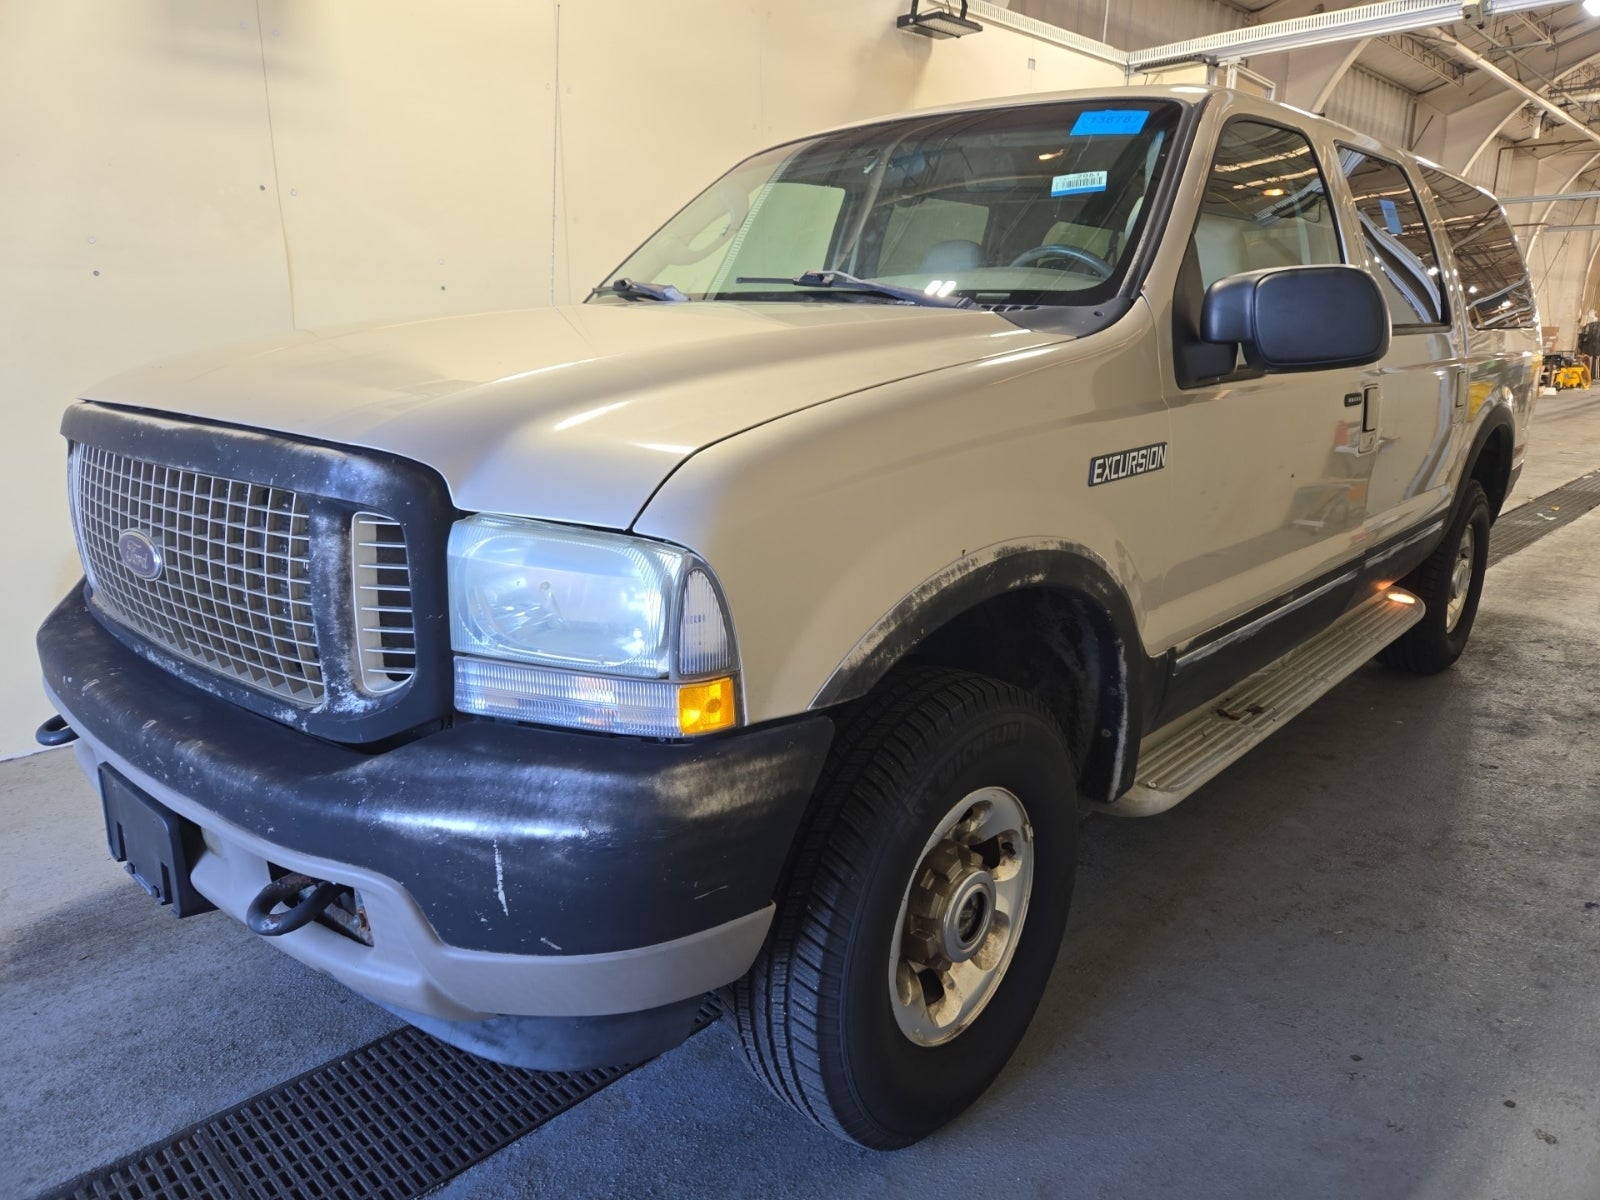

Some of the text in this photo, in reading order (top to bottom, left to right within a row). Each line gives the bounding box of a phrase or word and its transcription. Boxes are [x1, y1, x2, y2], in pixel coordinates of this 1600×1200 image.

[1092, 444, 1168, 484] EXCURSION
[126, 540, 148, 570] Ford
[937, 721, 1020, 788] MICHELIN
